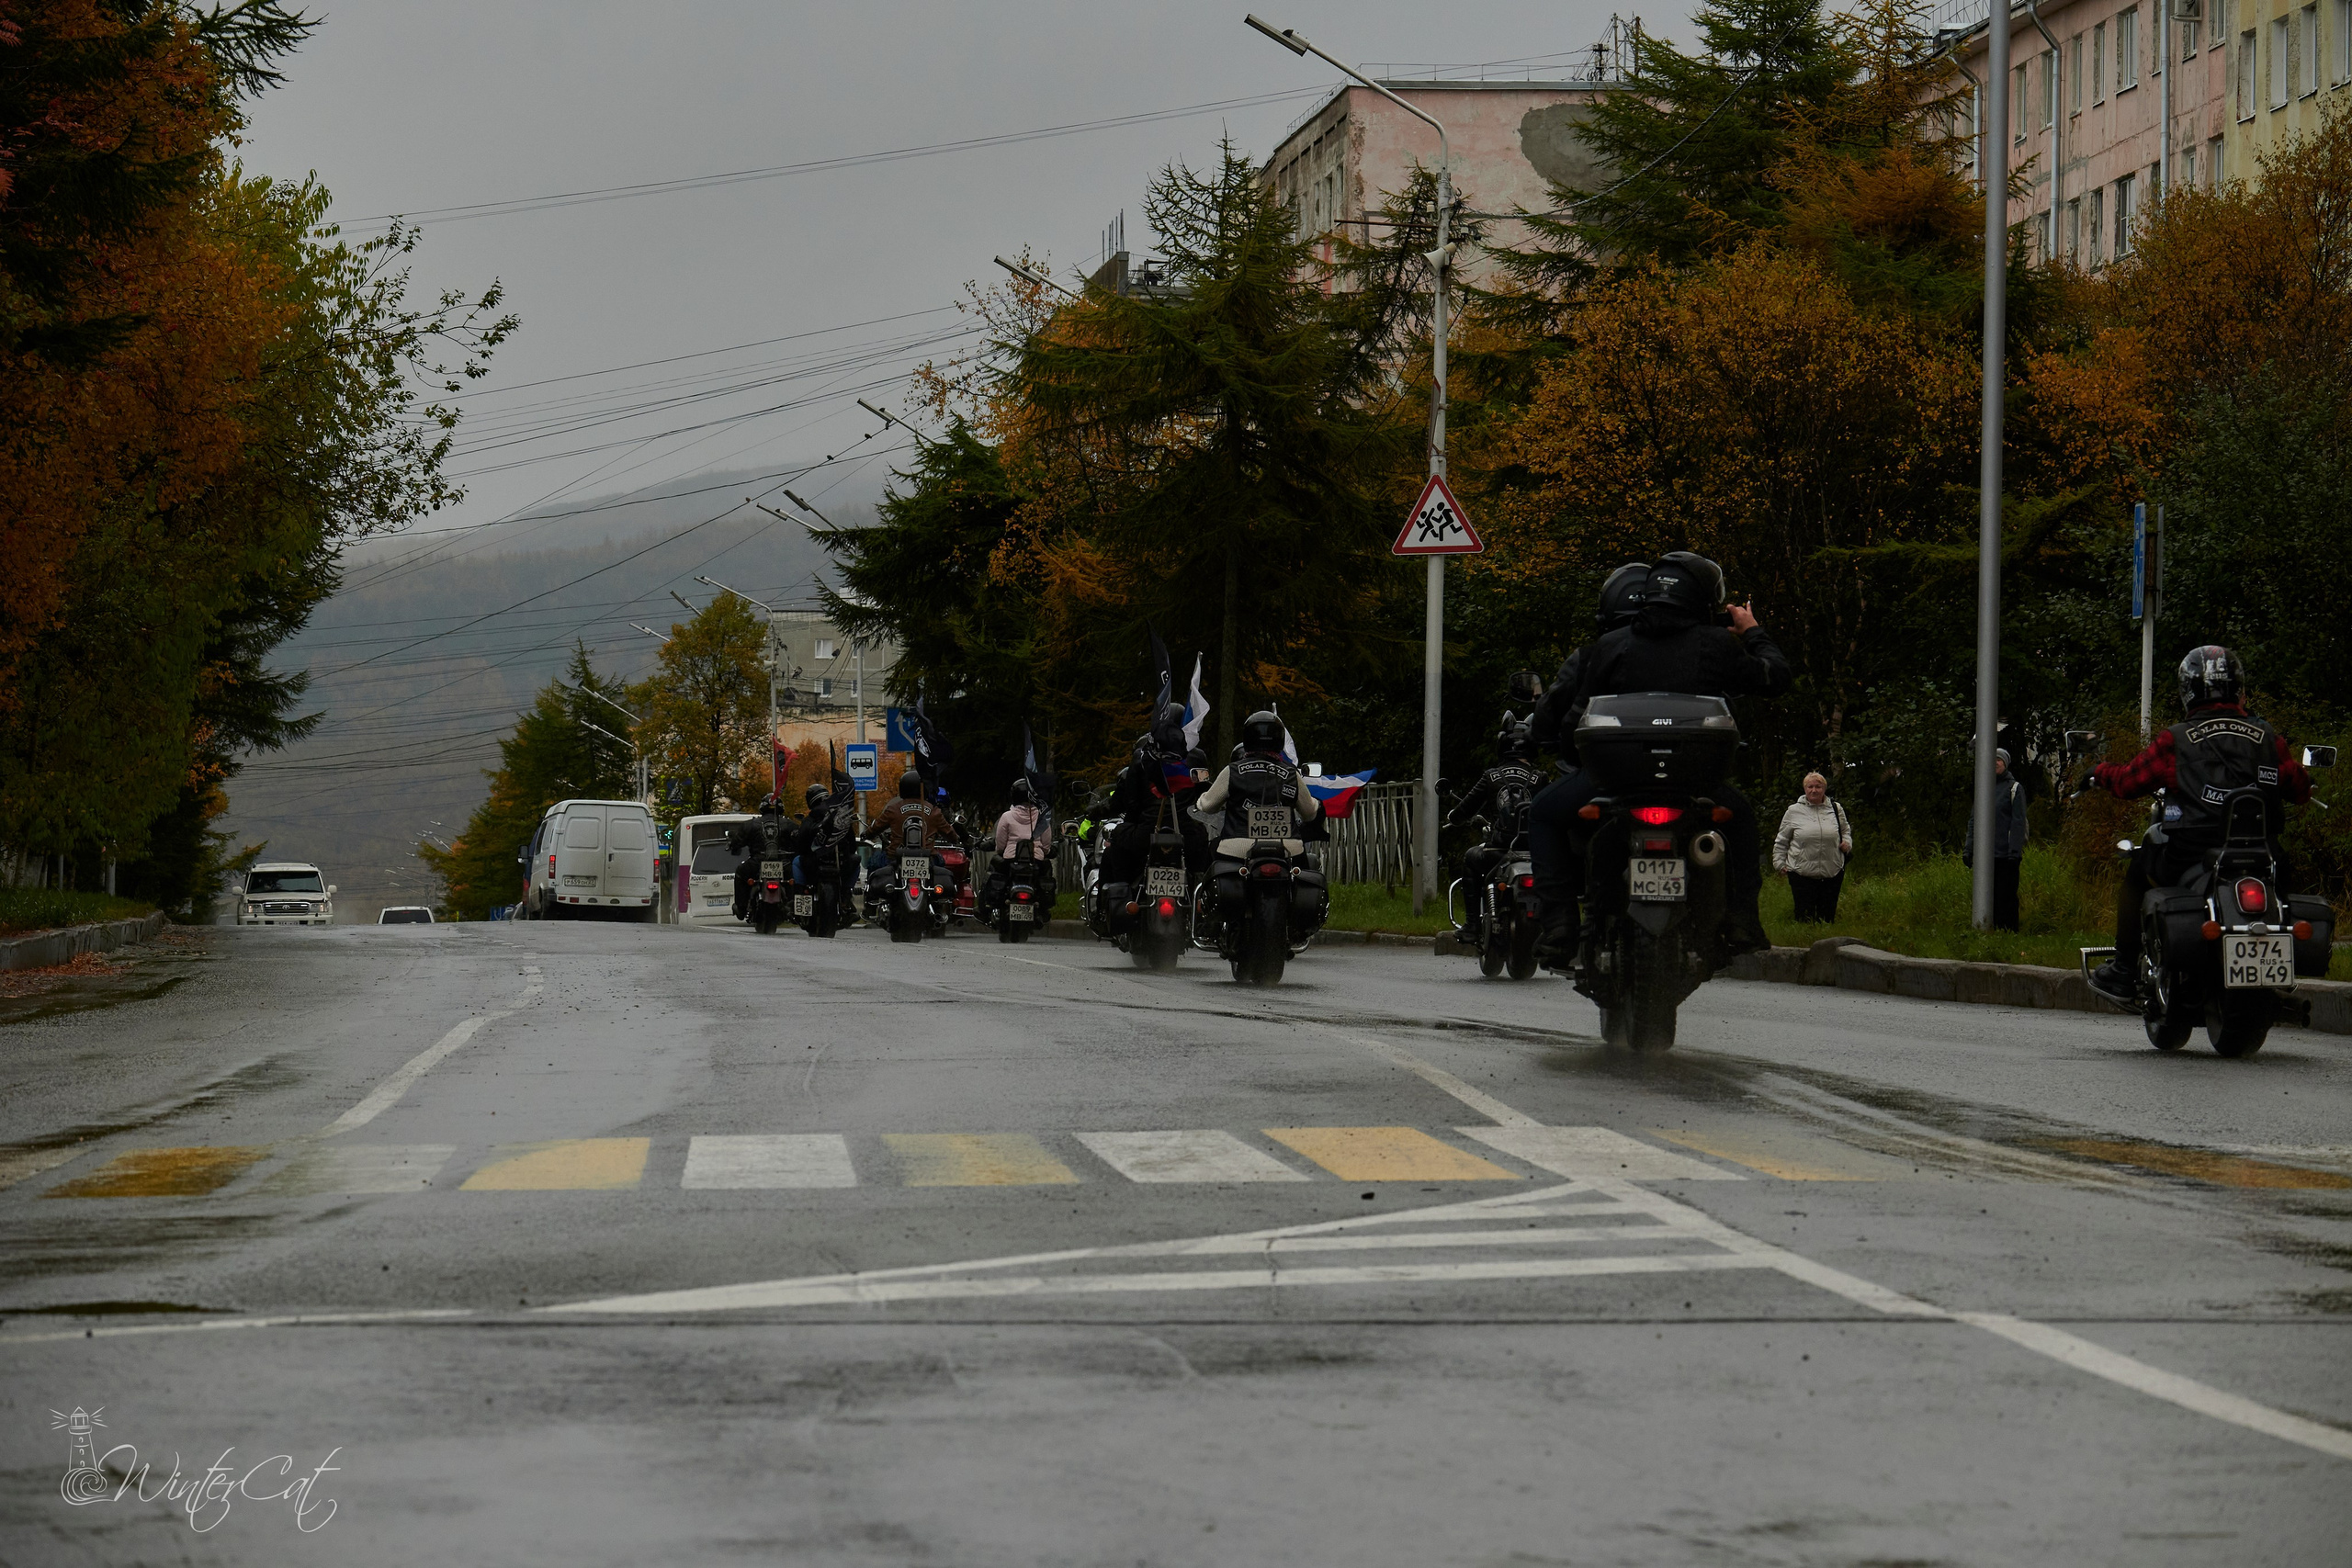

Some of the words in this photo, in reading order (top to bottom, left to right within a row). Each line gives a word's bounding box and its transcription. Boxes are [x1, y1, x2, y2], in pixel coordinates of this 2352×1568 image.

[2229, 723, 2260, 739] OWLS
[1240, 763, 1265, 772] POLAR
[1516, 770, 1536, 781] OWS
[2259, 771, 2278, 780] MCC
[1254, 811, 1284, 821] 0335
[1273, 826, 1288, 836] 49
[1637, 861, 1676, 874] 0117
[1153, 870, 1180, 881] 0228
[1169, 885, 1182, 896] 49
[1662, 881, 1681, 895] 49
[804, 896, 811, 905] 49
[2235, 942, 2282, 958] 0374
[2266, 965, 2288, 983] 49
